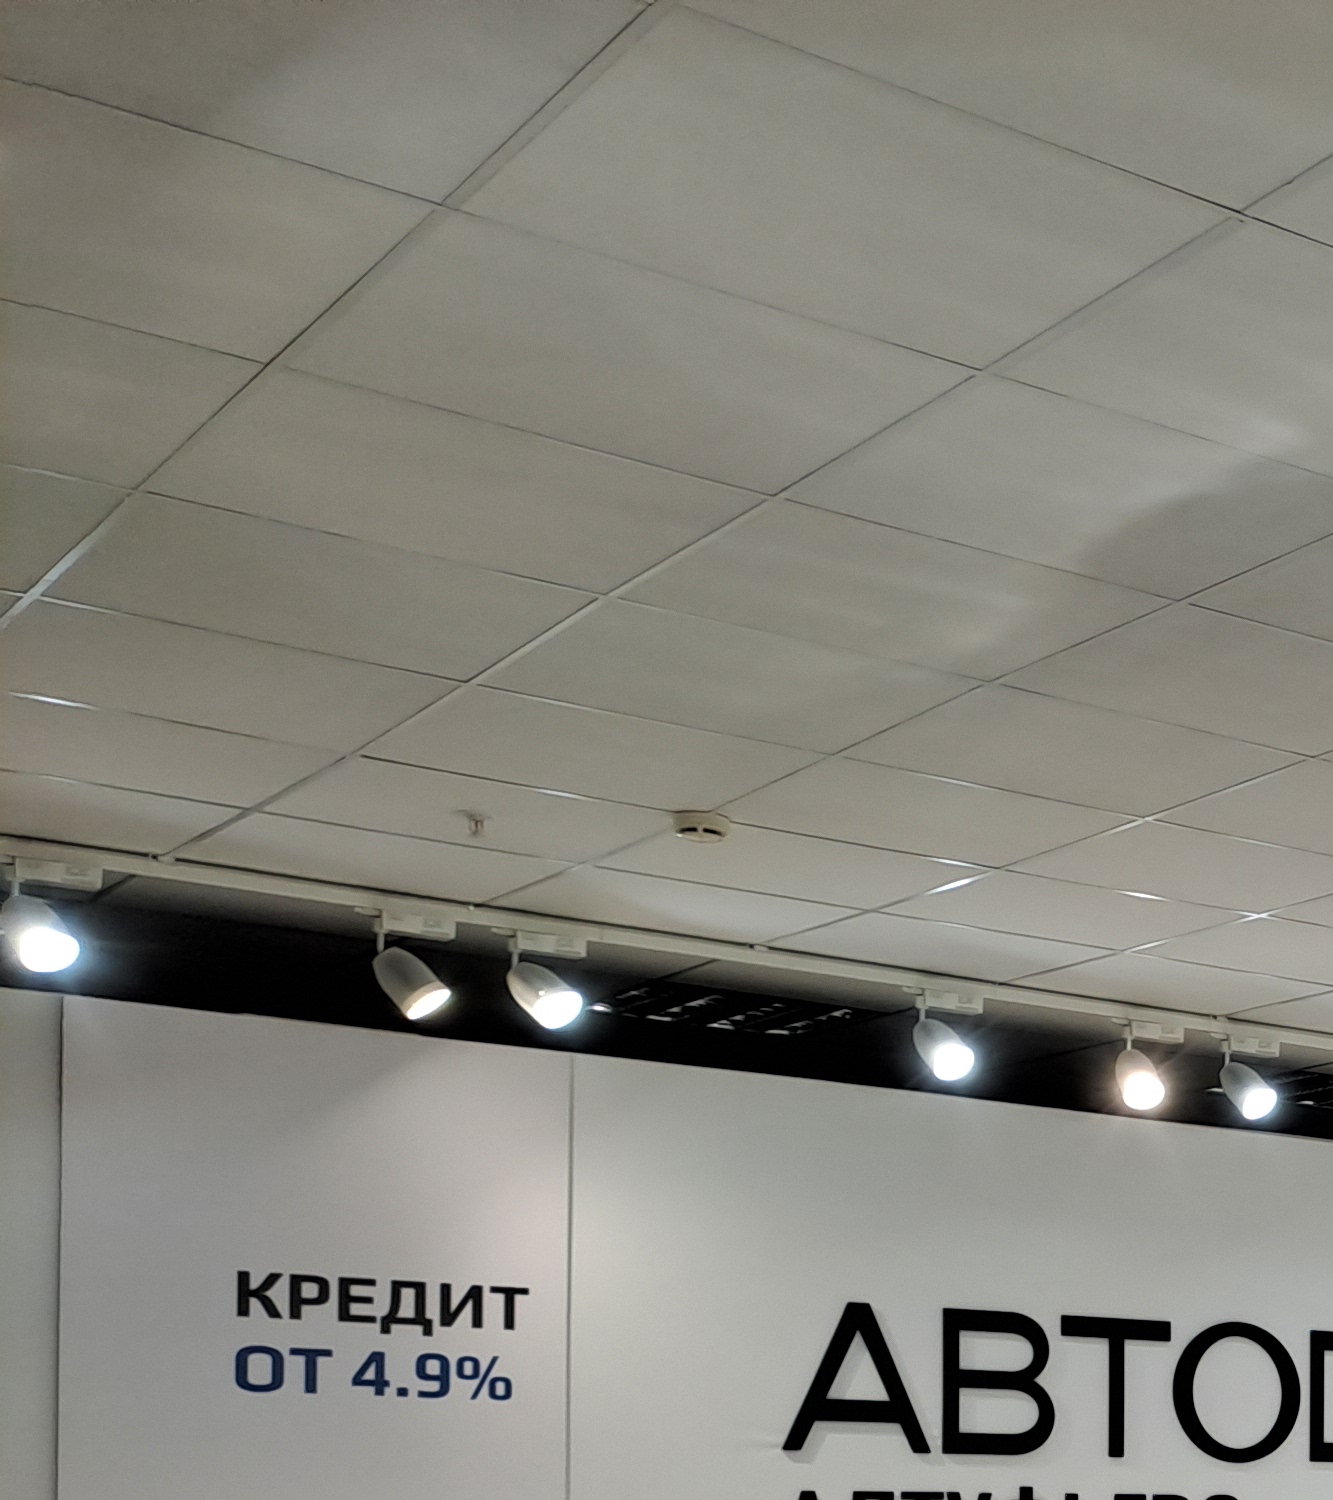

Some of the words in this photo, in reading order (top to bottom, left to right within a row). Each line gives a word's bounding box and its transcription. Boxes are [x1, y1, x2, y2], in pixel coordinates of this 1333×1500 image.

[236, 1270, 530, 1337] КРЕДИТ
[234, 1345, 333, 1394] ОТ
[351, 1351, 513, 1401] 4.9%
